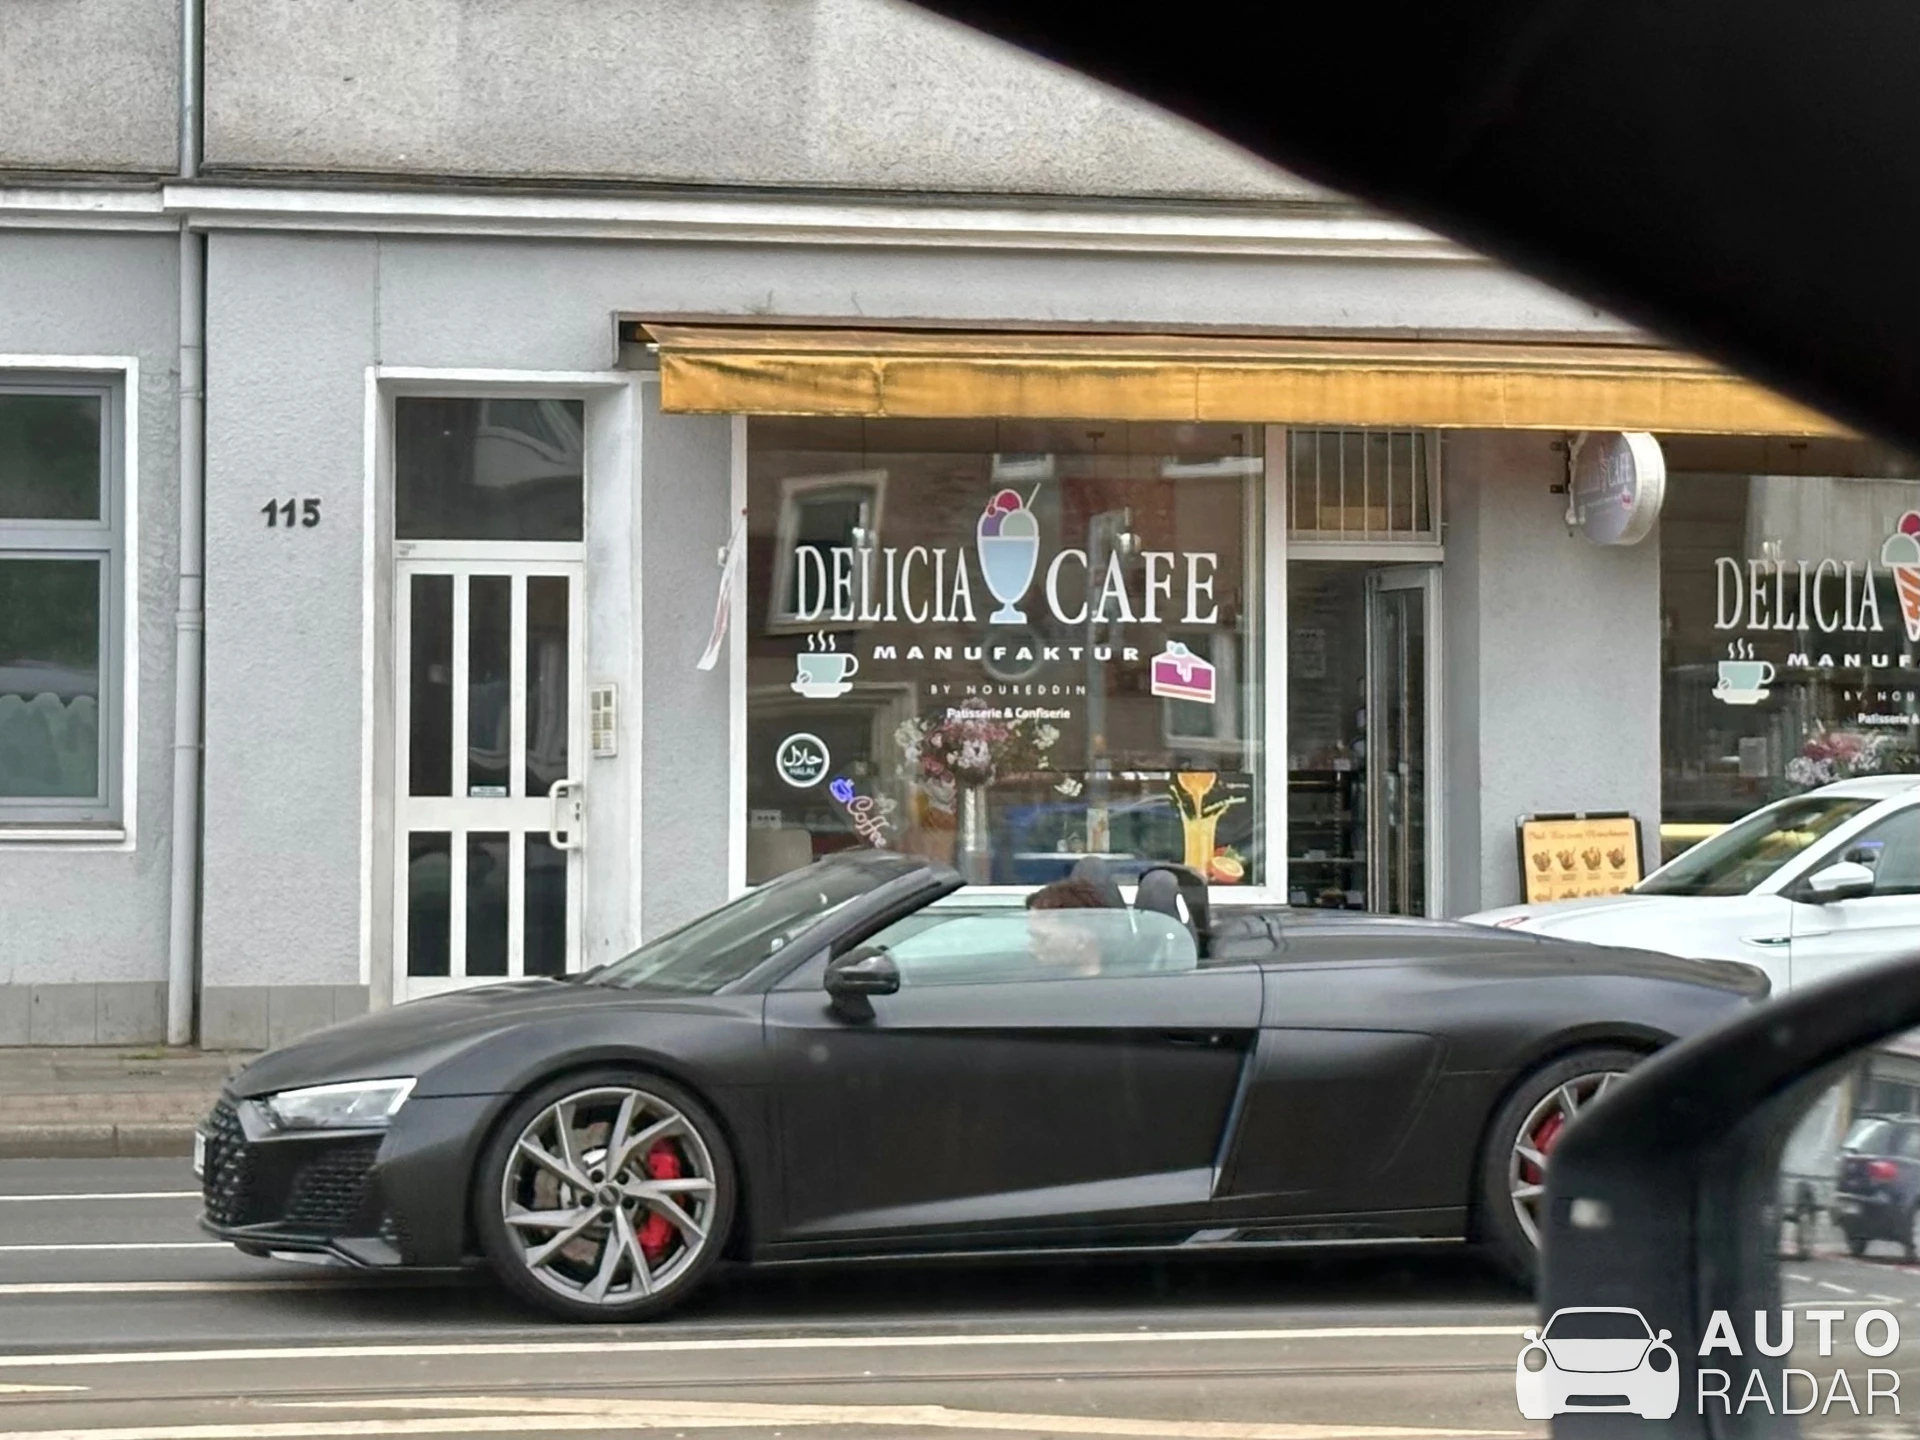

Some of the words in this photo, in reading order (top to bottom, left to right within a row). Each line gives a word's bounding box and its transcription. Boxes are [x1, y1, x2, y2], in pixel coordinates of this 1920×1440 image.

[261, 498, 321, 527] 115
[794, 545, 977, 624] DELICIA
[1045, 549, 1219, 625] CAFE
[1713, 556, 1884, 633] DELICIA
[872, 645, 1140, 661] MANUFAKTUR
[1787, 653, 1920, 668] MANUF
[930, 684, 951, 695] BY
[966, 684, 1087, 696] NOUREDDIN
[946, 707, 1002, 720] Patisserie
[1004, 707, 1013, 719] &
[1015, 707, 1071, 719] Confiserie
[783, 745, 823, 767] حلال
[847, 796, 890, 849] Coffee
